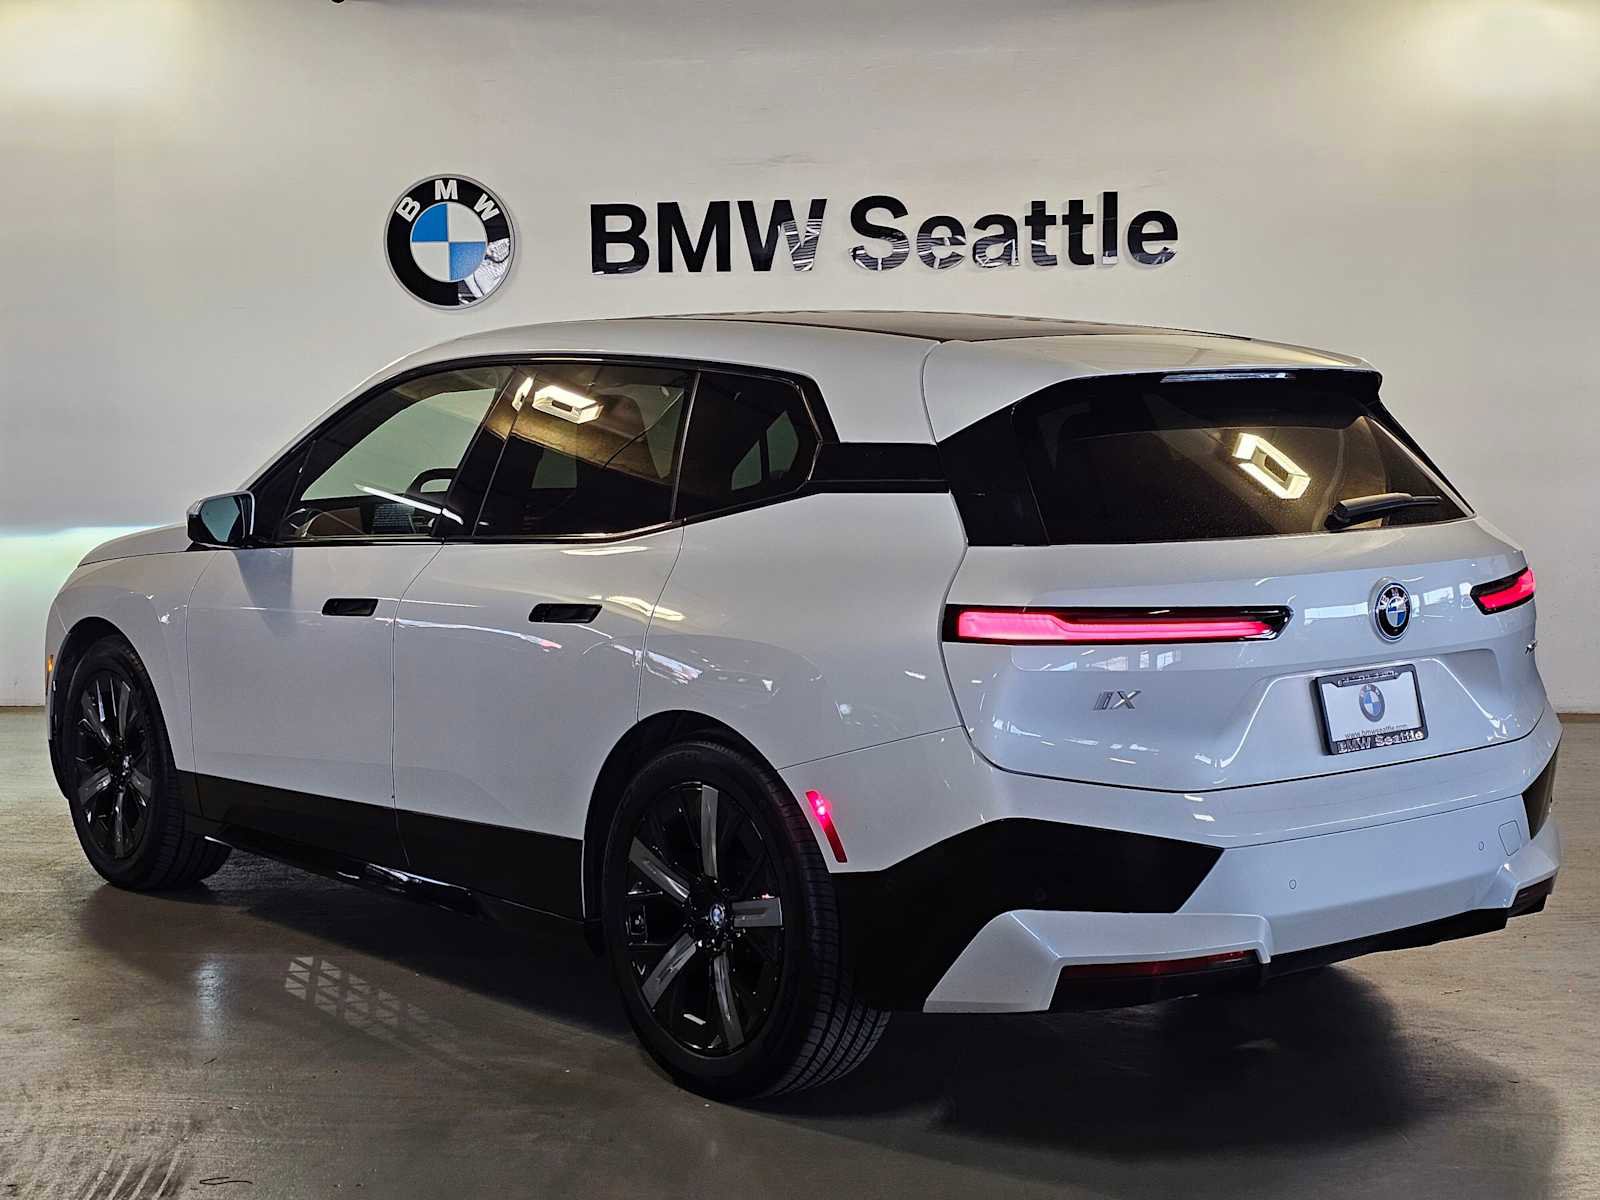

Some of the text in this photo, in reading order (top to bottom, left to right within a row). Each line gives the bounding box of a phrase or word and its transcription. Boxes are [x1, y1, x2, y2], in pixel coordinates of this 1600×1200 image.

[396, 179, 499, 222] BMW
[590, 191, 1178, 275] BMW Seattle
[1337, 730, 1424, 753] BMW Seattle
